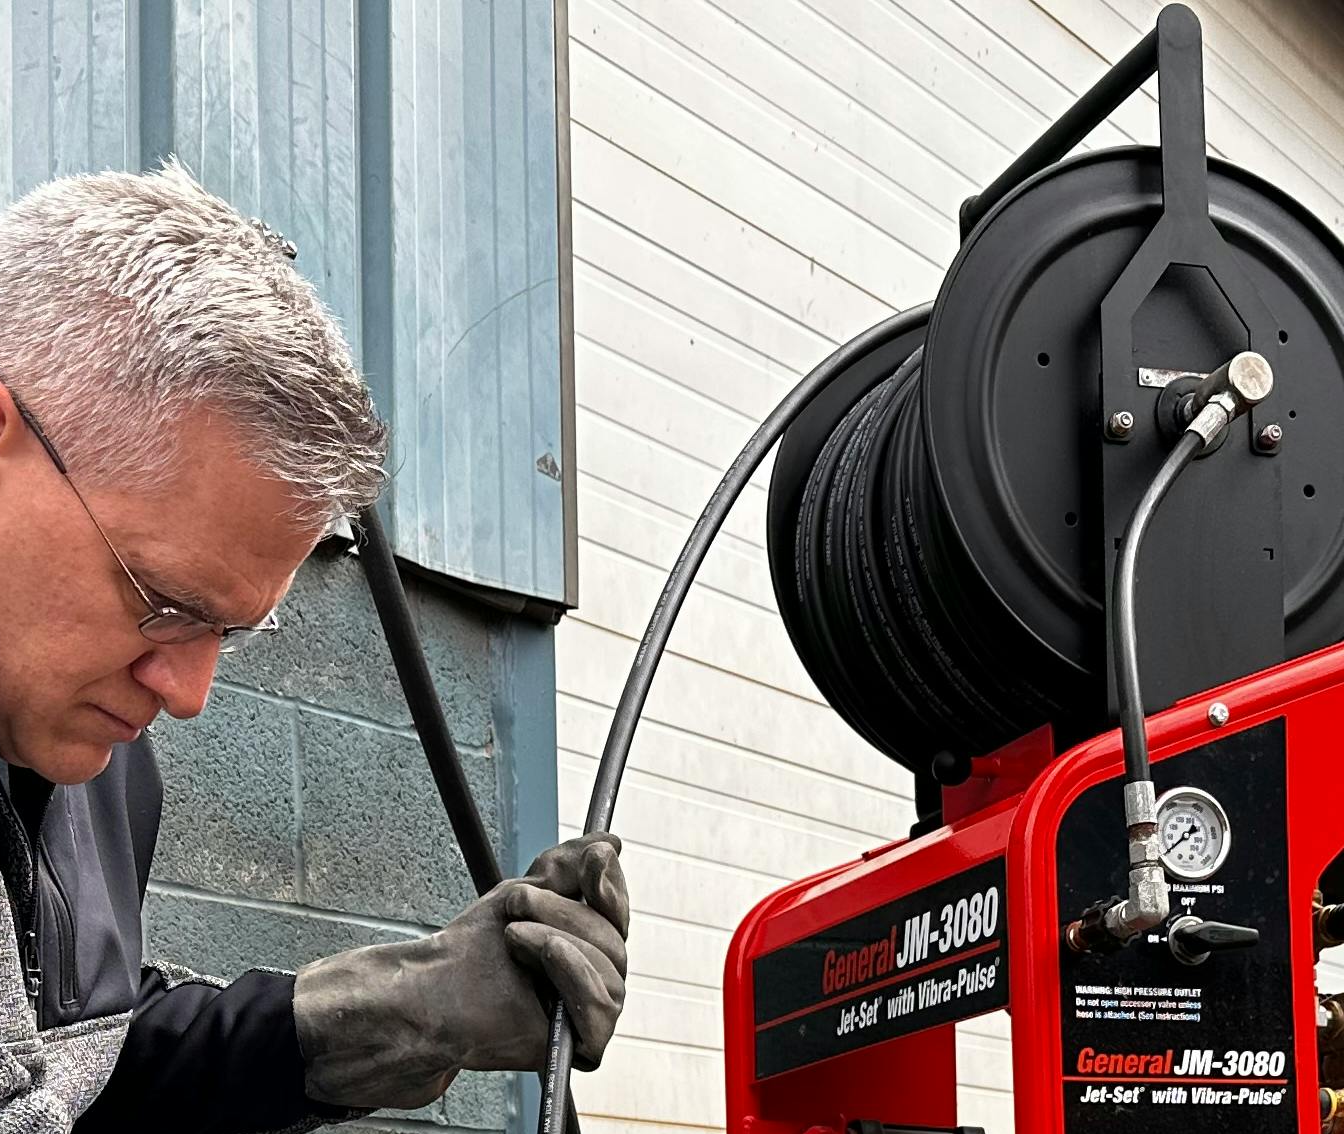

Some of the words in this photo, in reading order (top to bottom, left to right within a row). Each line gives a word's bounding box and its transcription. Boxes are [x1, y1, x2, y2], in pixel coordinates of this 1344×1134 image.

[1211, 884, 1225, 894] PSI
[1180, 897, 1197, 906] OFF
[822, 925, 897, 995] General
[896, 886, 999, 969] JM-3080
[1147, 934, 1160, 943] ON
[1133, 987, 1173, 997] PRESSURE
[1174, 988, 1202, 997] OUTLET
[887, 986, 915, 1020] with
[1075, 997, 1086, 1007] Do
[1087, 998, 1099, 1007] not
[1100, 1000, 1119, 1009] open
[1075, 1009, 1094, 1019] hose
[1094, 1009, 1102, 1019] is
[1076, 1047, 1173, 1074] General
[1173, 1049, 1286, 1077] JM-3080
[1151, 1086, 1188, 1104] with
